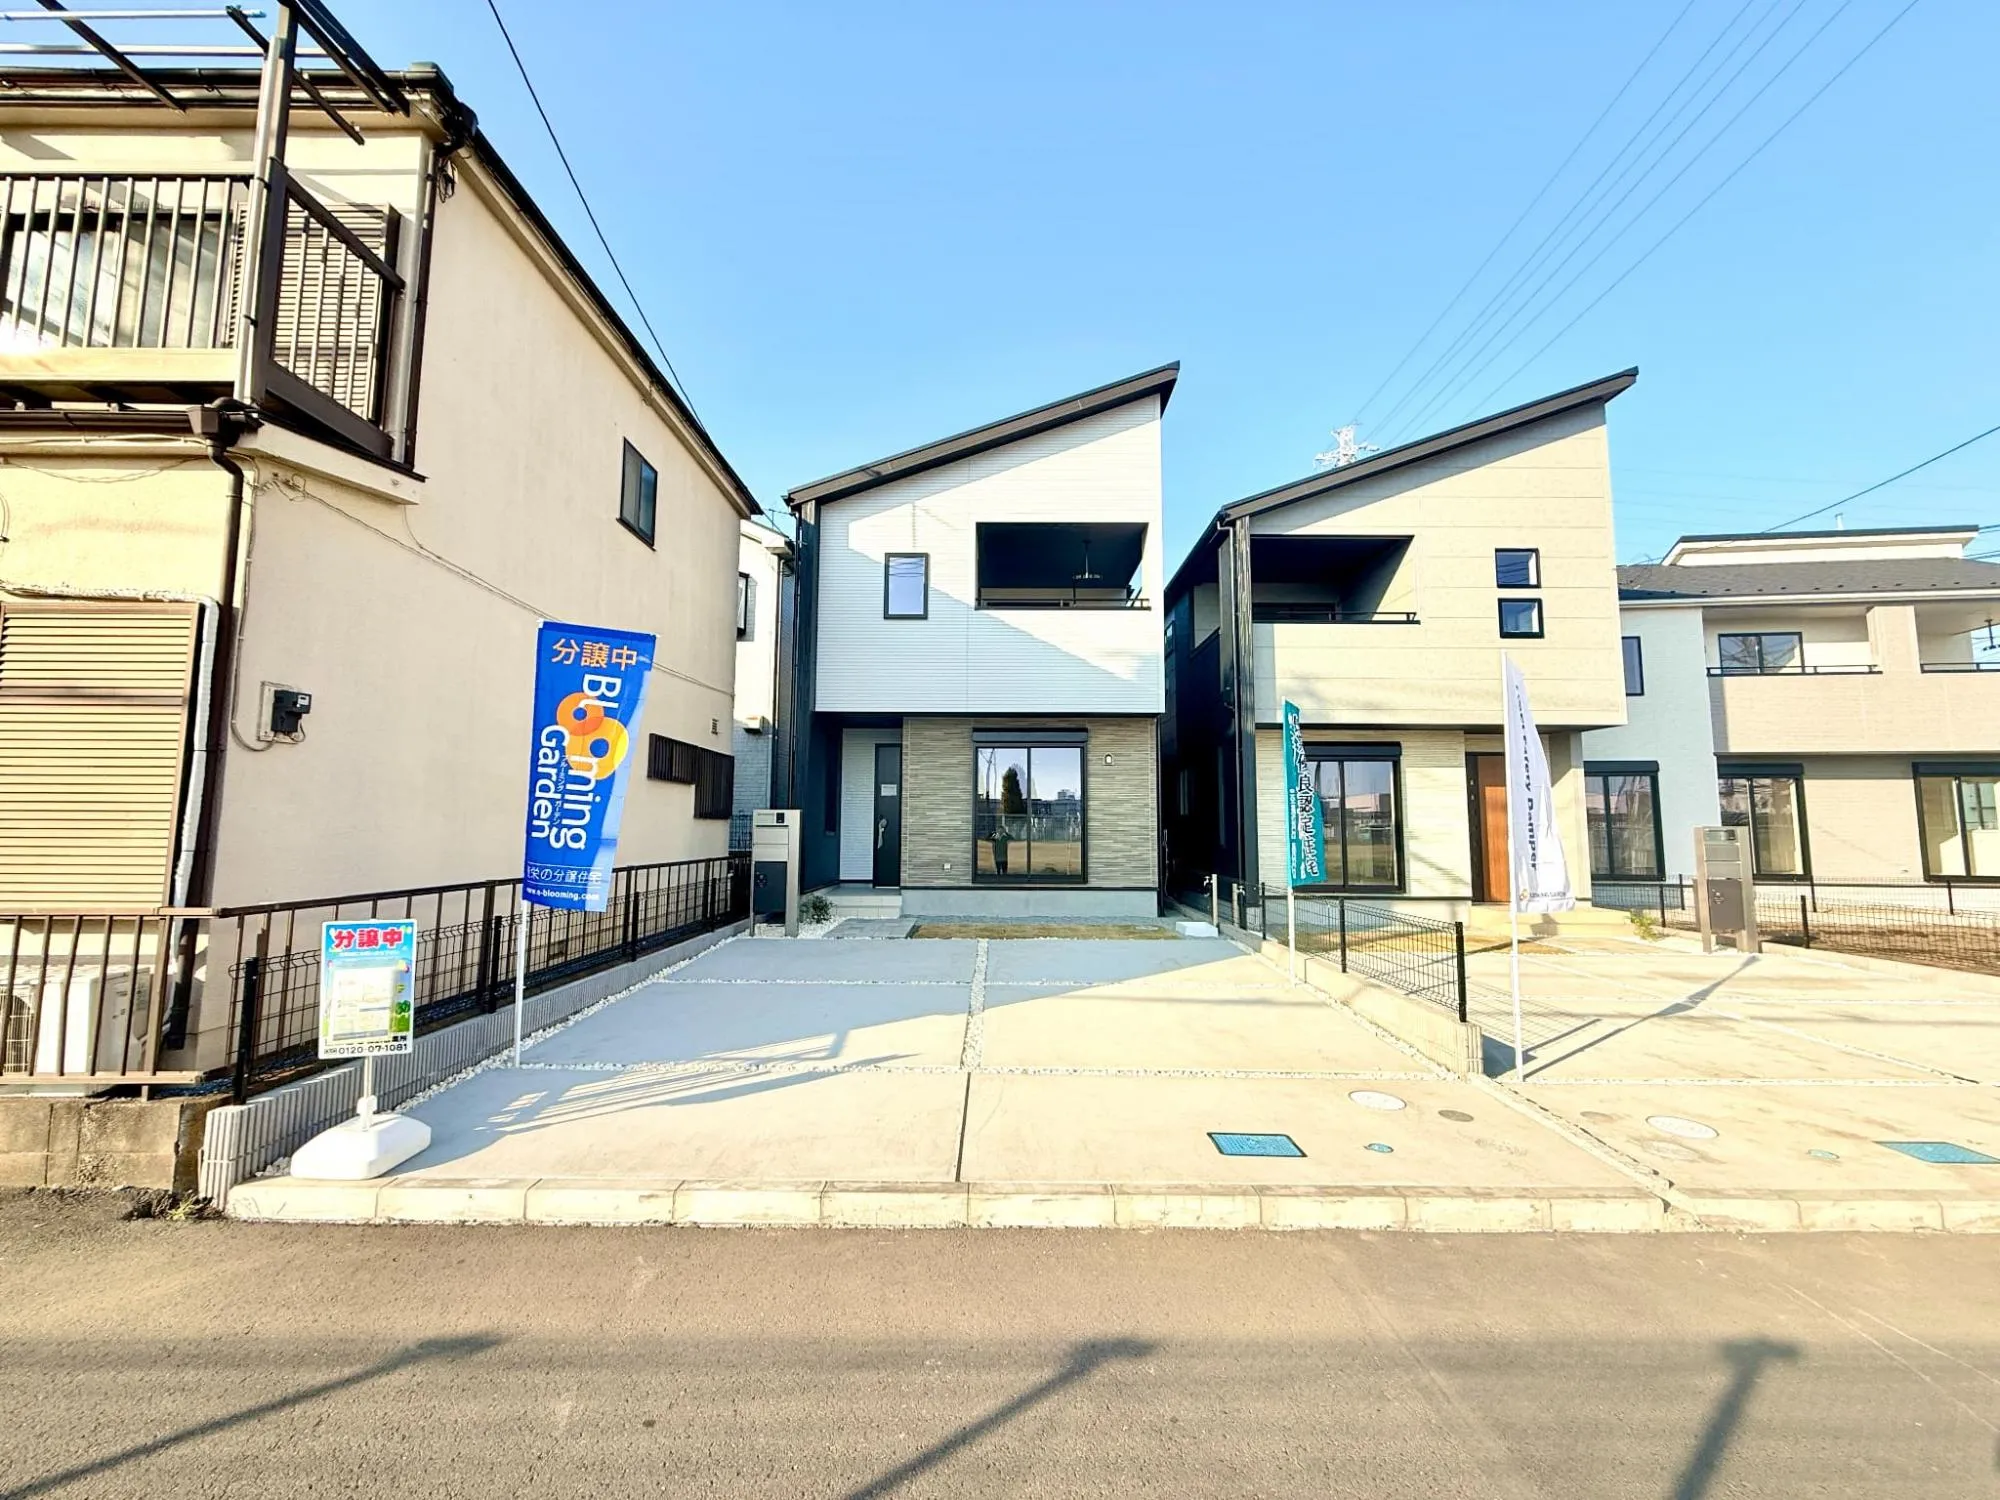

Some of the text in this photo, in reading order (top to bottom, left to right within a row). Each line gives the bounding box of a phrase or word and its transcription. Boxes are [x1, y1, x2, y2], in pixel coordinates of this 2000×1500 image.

[551, 637, 637, 672] 分譲中
[531, 673, 629, 851] Blooming Garden
[1527, 797, 1538, 872] Damper
[334, 928, 403, 949] 分譲中
